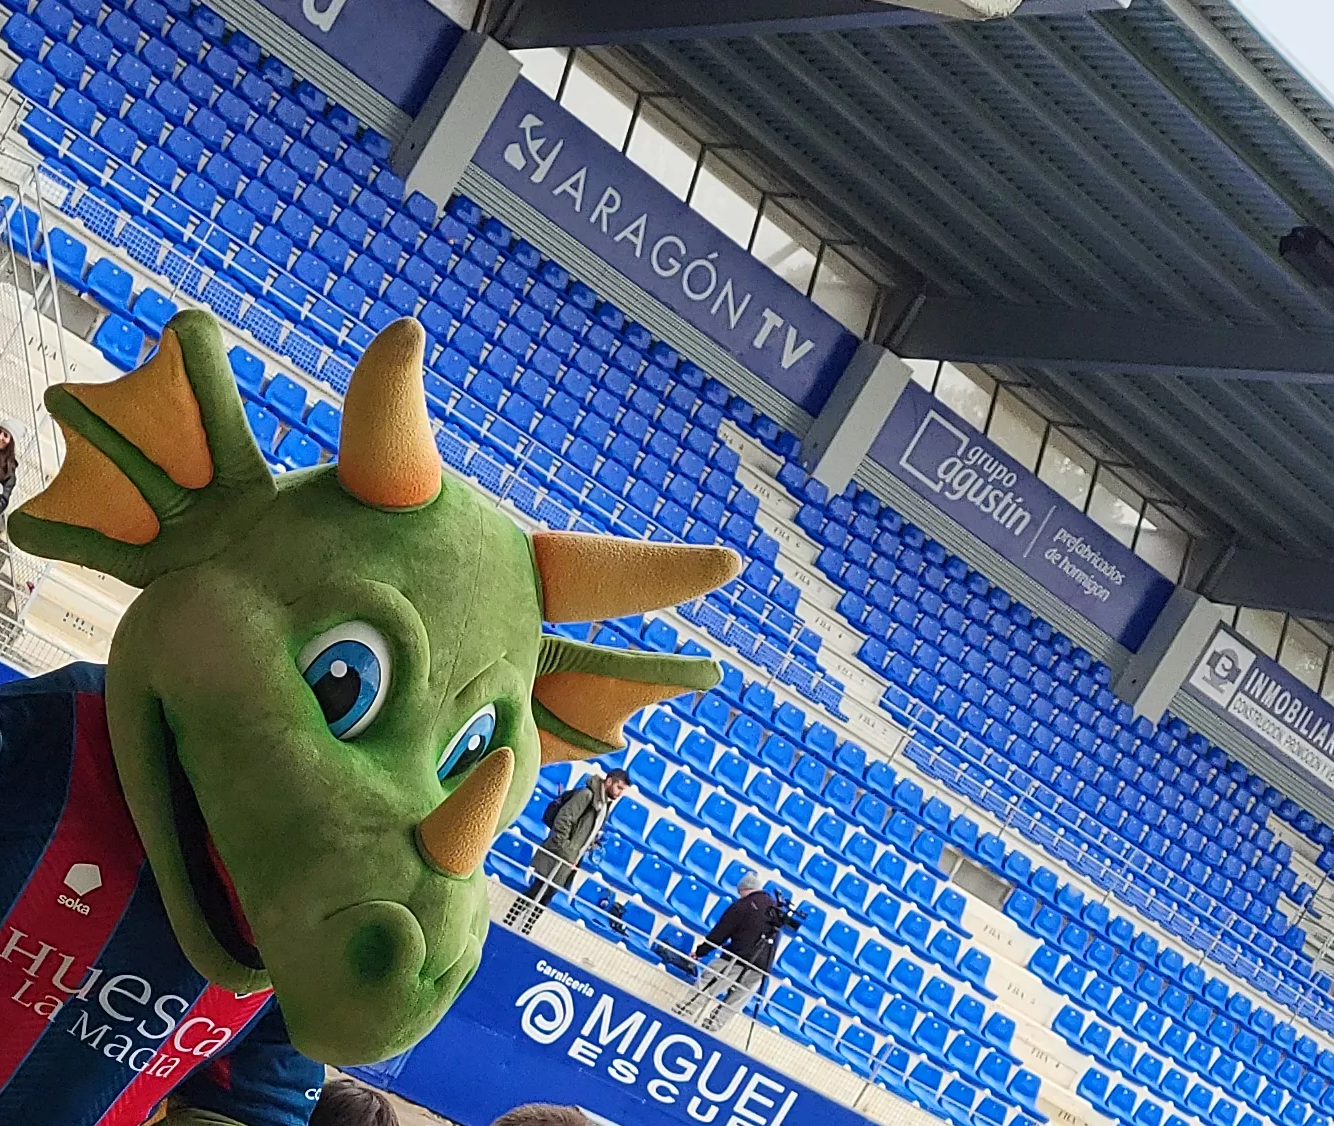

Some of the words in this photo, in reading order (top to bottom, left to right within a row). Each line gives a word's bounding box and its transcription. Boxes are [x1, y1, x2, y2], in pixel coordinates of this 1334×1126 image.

[553, 167, 751, 329] ARAGÓN
[752, 308, 815, 369] TV
[964, 441, 1018, 487] grupo
[937, 455, 1032, 537] agustín
[56, 893, 91, 916] soka
[11, 978, 67, 1024] La
[535, 959, 596, 998] Carniceria
